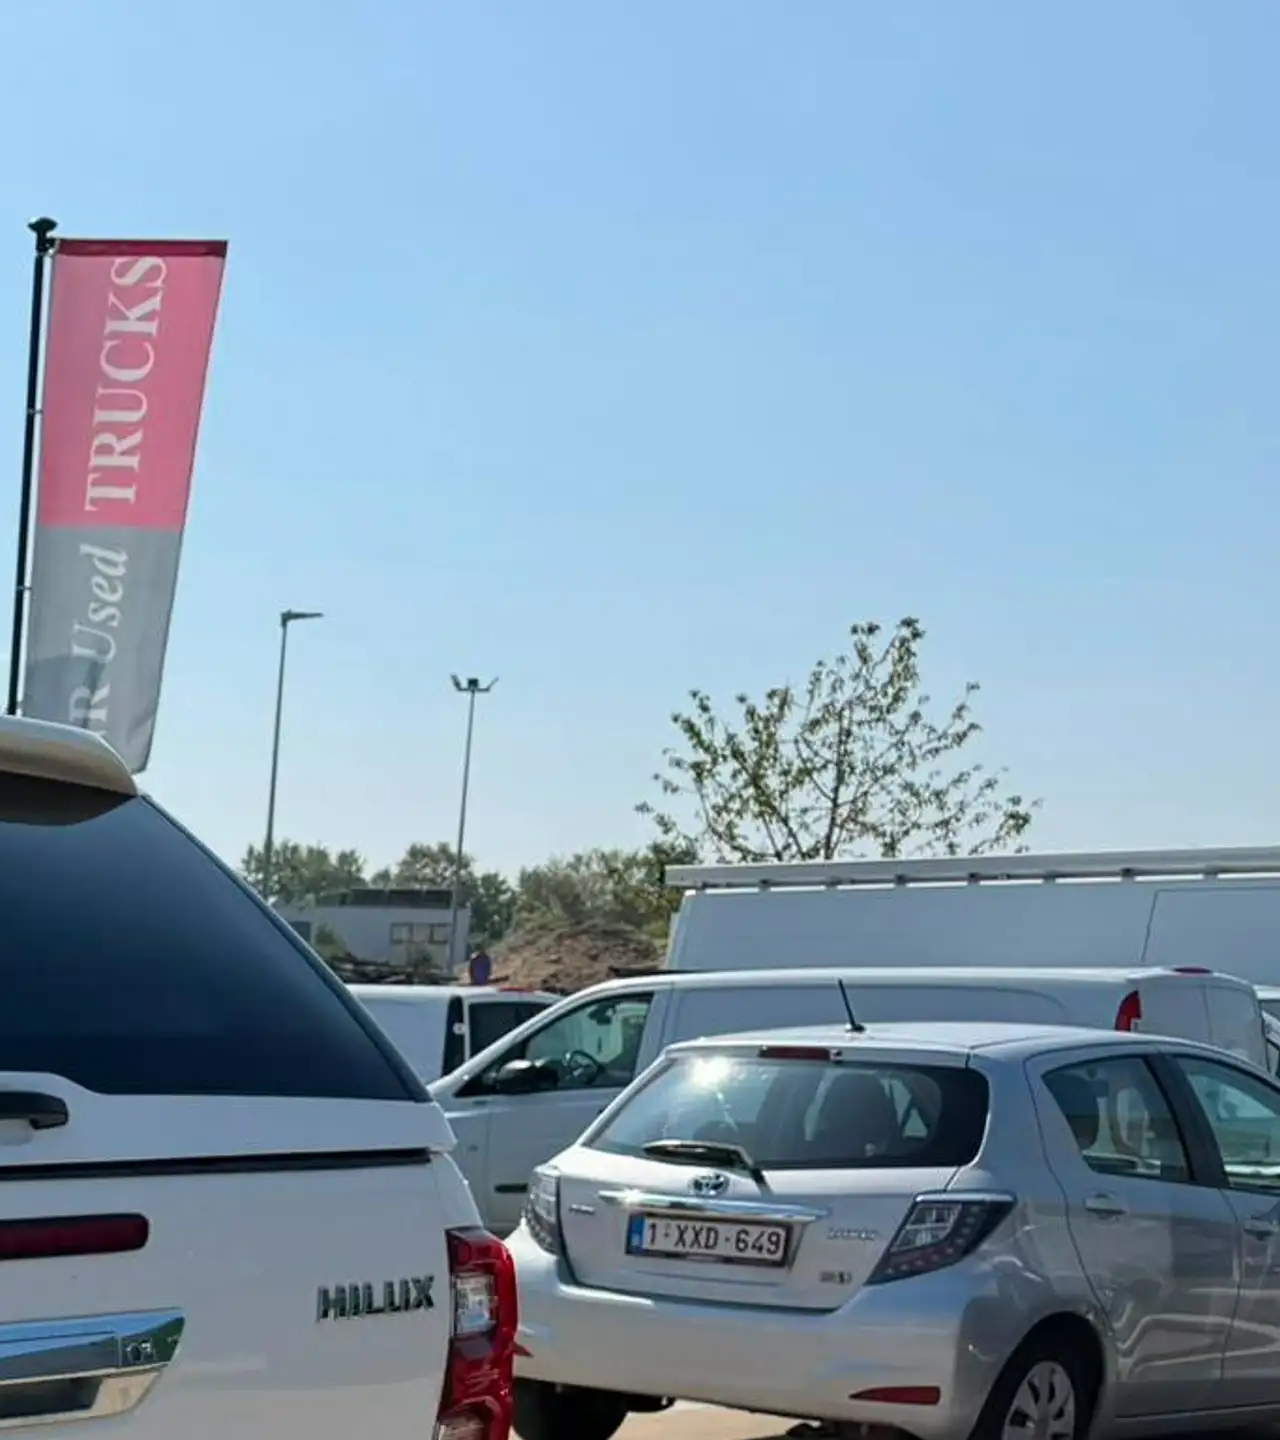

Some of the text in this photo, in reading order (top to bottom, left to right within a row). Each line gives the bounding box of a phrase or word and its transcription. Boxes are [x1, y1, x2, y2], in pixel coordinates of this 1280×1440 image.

[84, 255, 167, 512] TRUCKS
[70, 543, 130, 665] Used
[316, 1274, 435, 1321] HILUX
